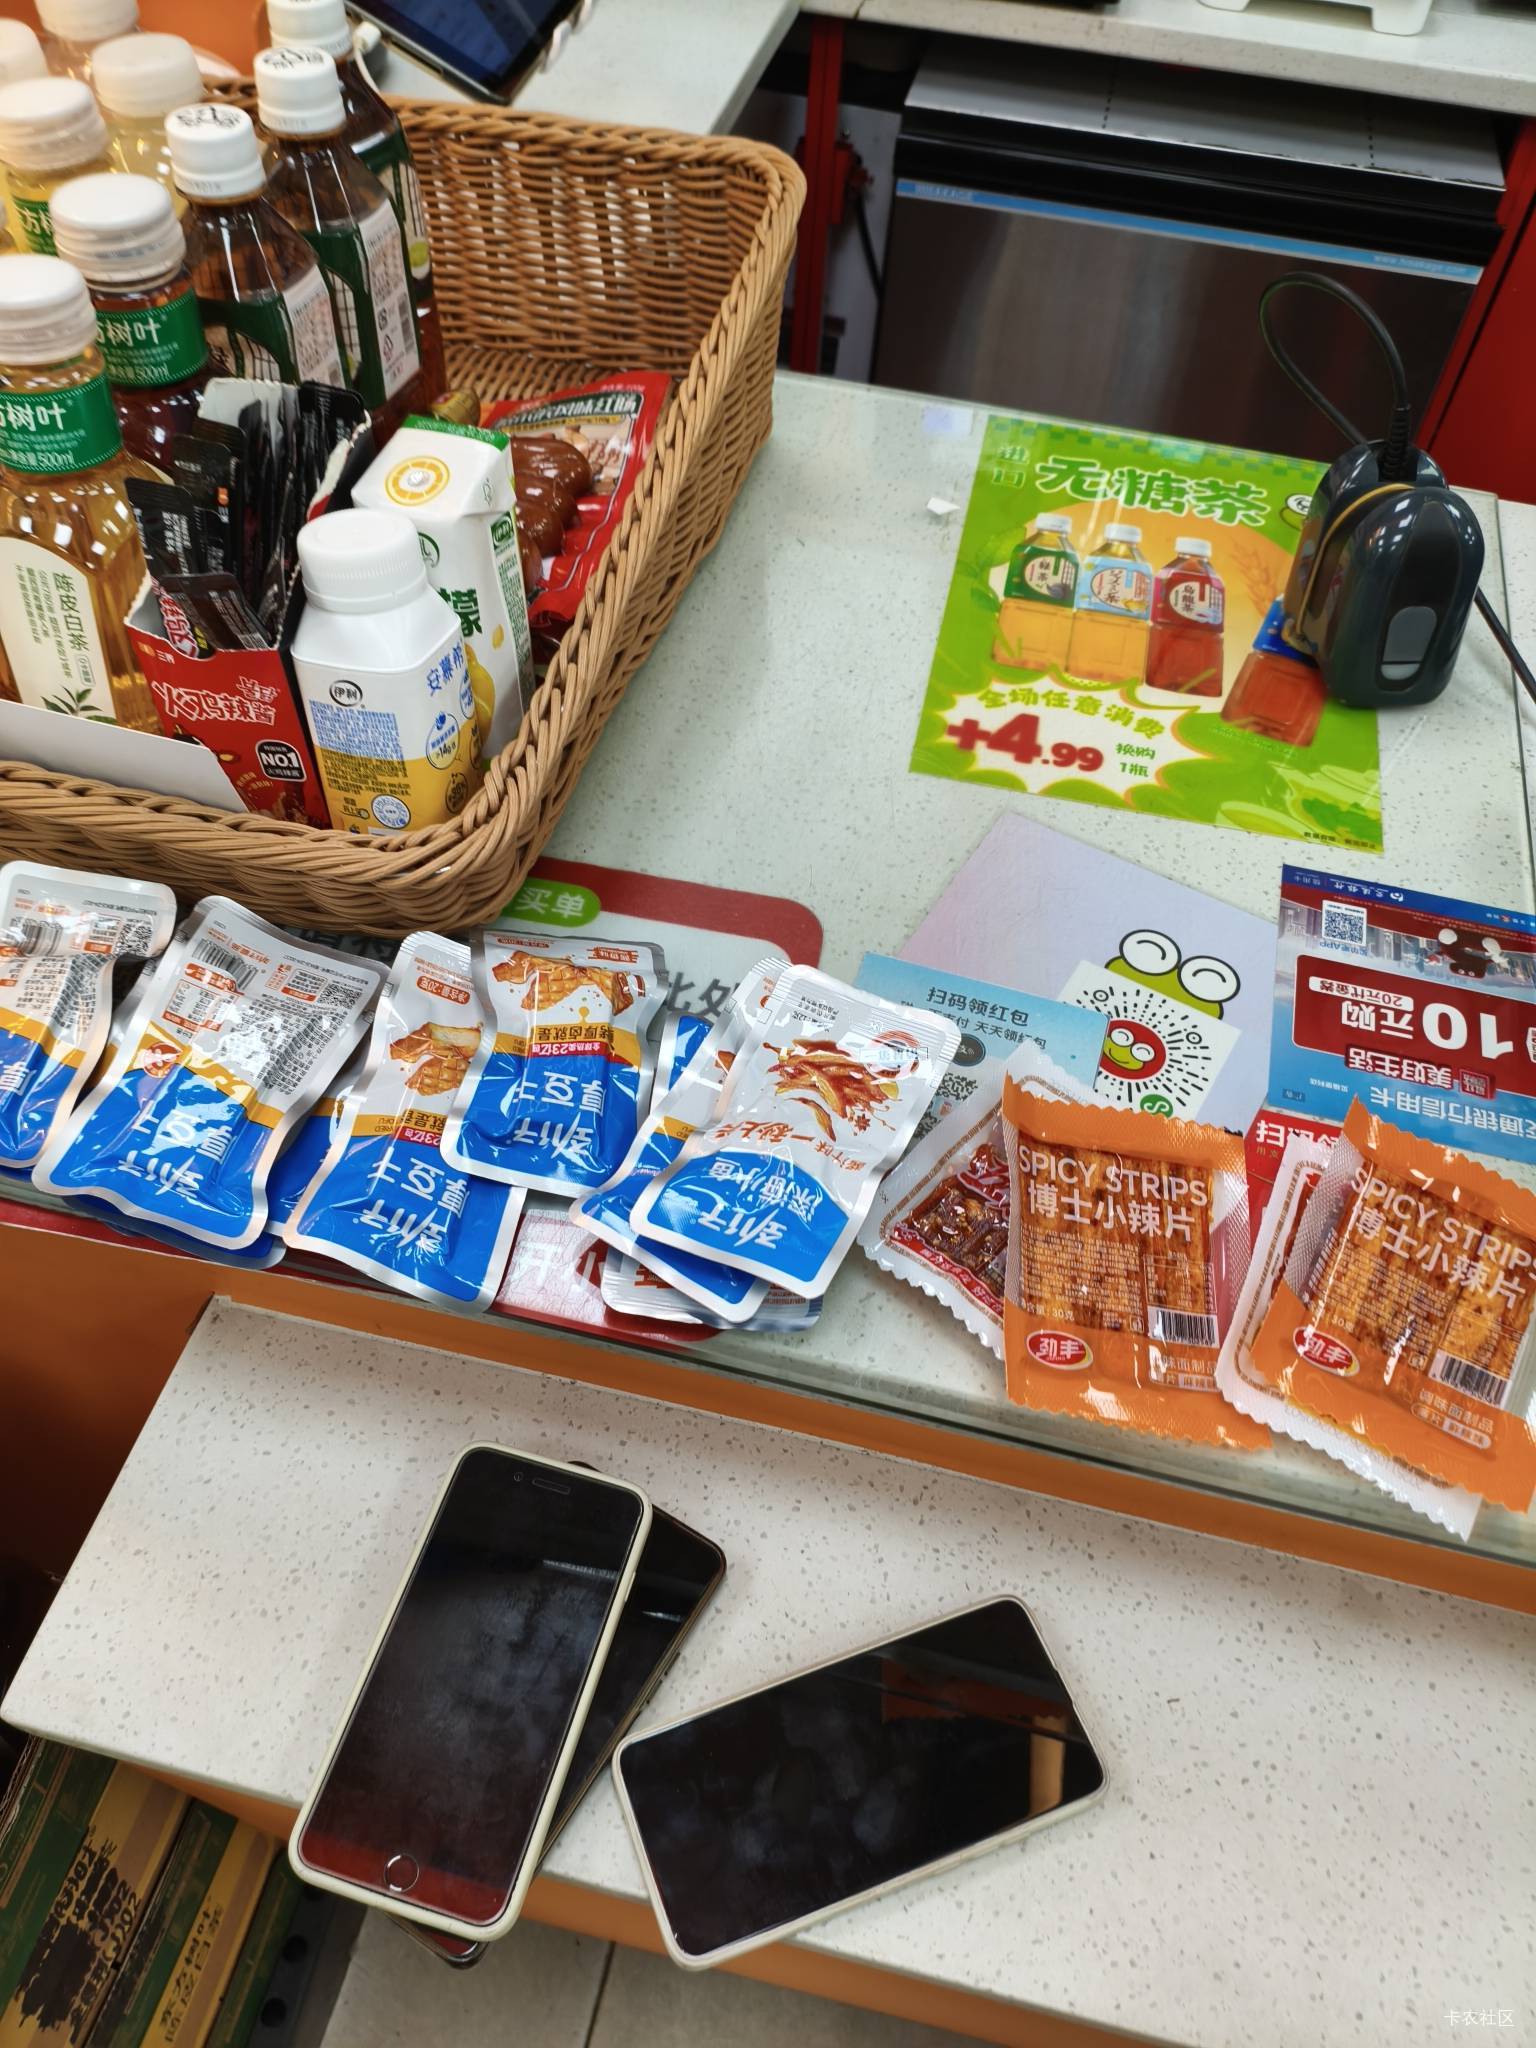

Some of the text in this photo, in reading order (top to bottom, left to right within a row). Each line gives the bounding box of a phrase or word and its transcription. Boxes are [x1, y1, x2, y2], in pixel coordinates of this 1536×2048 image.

[1035, 455, 1270, 528] 无糖茶
[333, 686, 359, 702] 伊利
[976, 686, 1170, 742] 全场任意消费
[260, 751, 300, 769] NO.1
[945, 711, 1104, 774] +4.99
[1115, 743, 1156, 761] 换购
[516, 886, 587, 919] 买单
[926, 985, 1029, 1027] 扫码领红包
[1319, 978, 1405, 1008] 20元代金券
[514, 1071, 606, 1114] 厚豆干
[1348, 1047, 1453, 1089] 美好生活
[511, 1109, 594, 1160] 劲仔
[1368, 1085, 1536, 1140] 交通银行信用卡
[132, 1110, 236, 1167] 厚豆干
[117, 1150, 205, 1199] 劲仔
[367, 1146, 469, 1219] 厚豆干
[1018, 1144, 1209, 1208] SPICY STRIPS
[1351, 1167, 1437, 1230] SPICY
[362, 1198, 443, 1250] 劲仔
[699, 1202, 789, 1249] 劲仔
[1026, 1178, 1196, 1245] 博士小辣片
[1353, 1205, 1526, 1310] 博士小辣片
